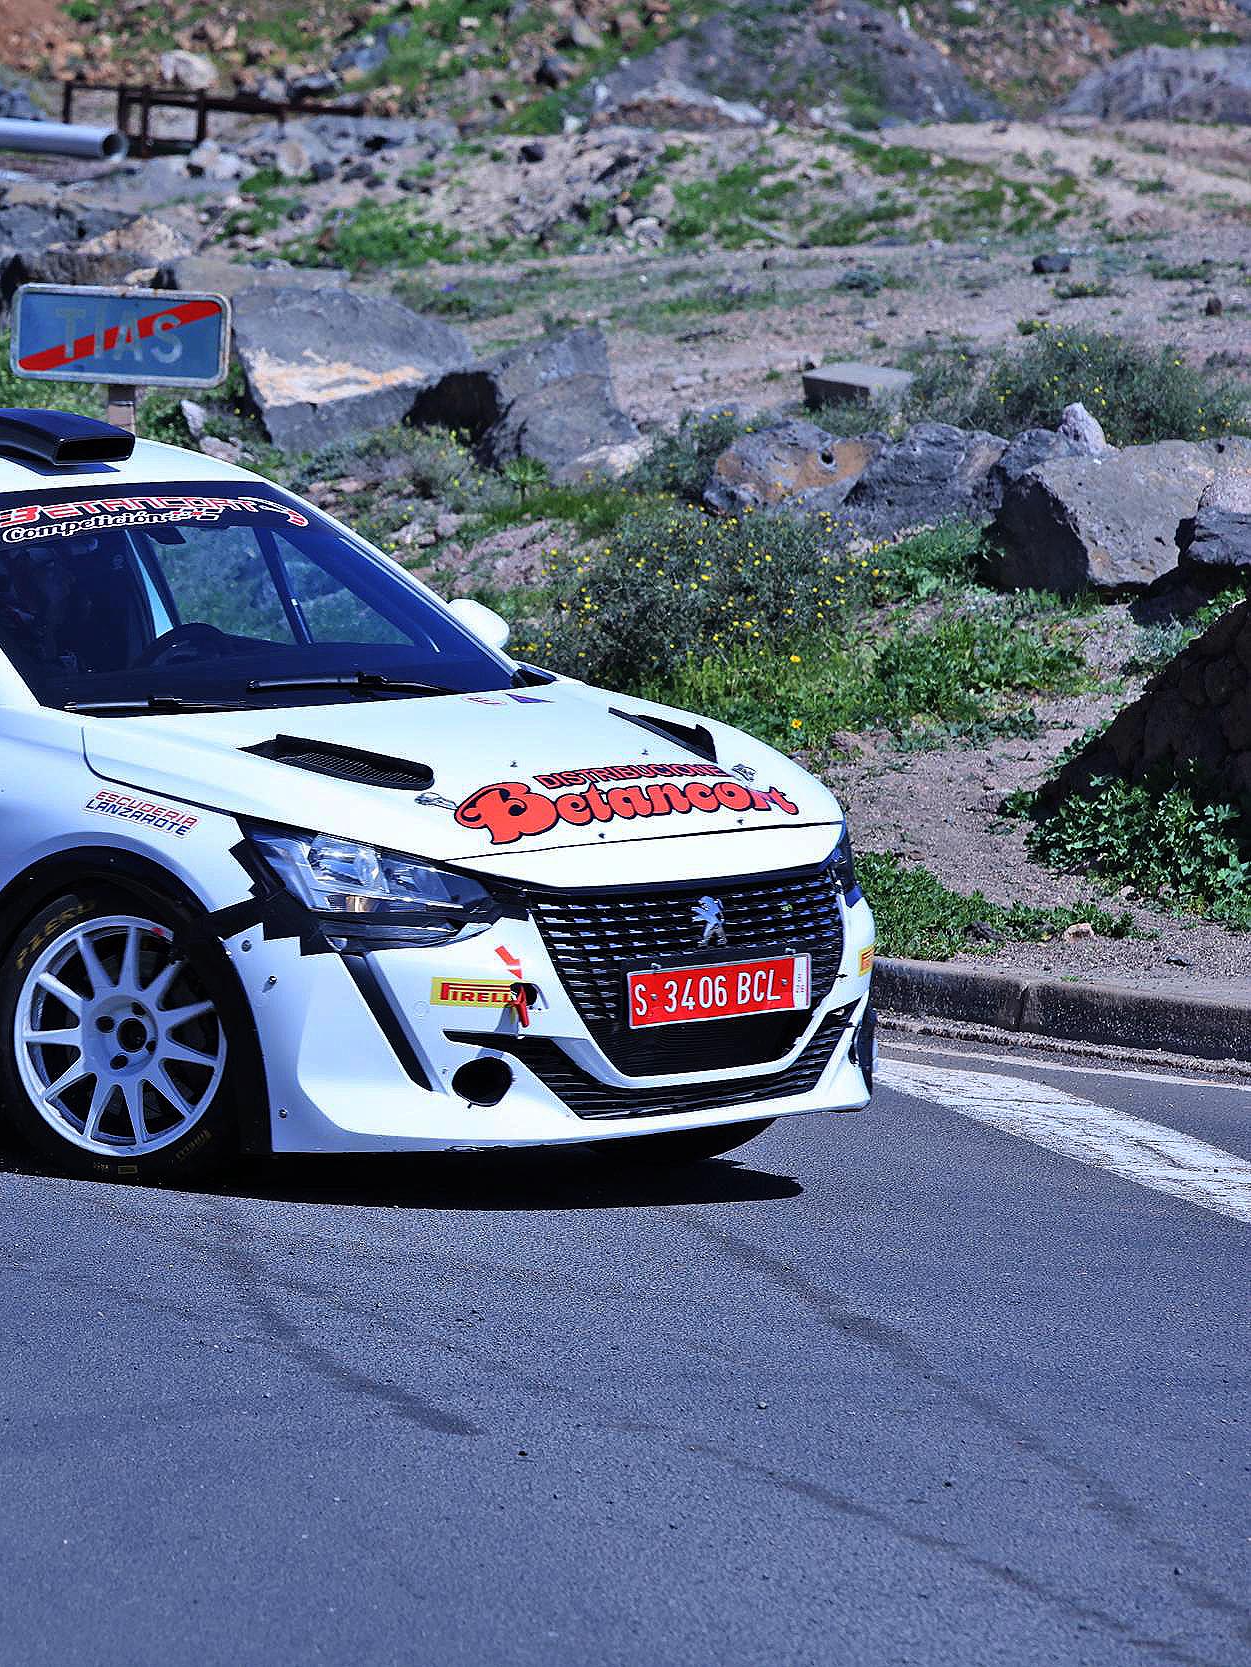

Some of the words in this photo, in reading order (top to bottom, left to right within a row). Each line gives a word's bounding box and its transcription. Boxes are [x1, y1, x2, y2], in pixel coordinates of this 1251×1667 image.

[85, 799, 190, 836] LANZAROTE
[95, 791, 198, 827] ESCUDERIA
[634, 983, 648, 1017] S
[663, 975, 729, 1014] 3406
[737, 968, 782, 1005] BCL
